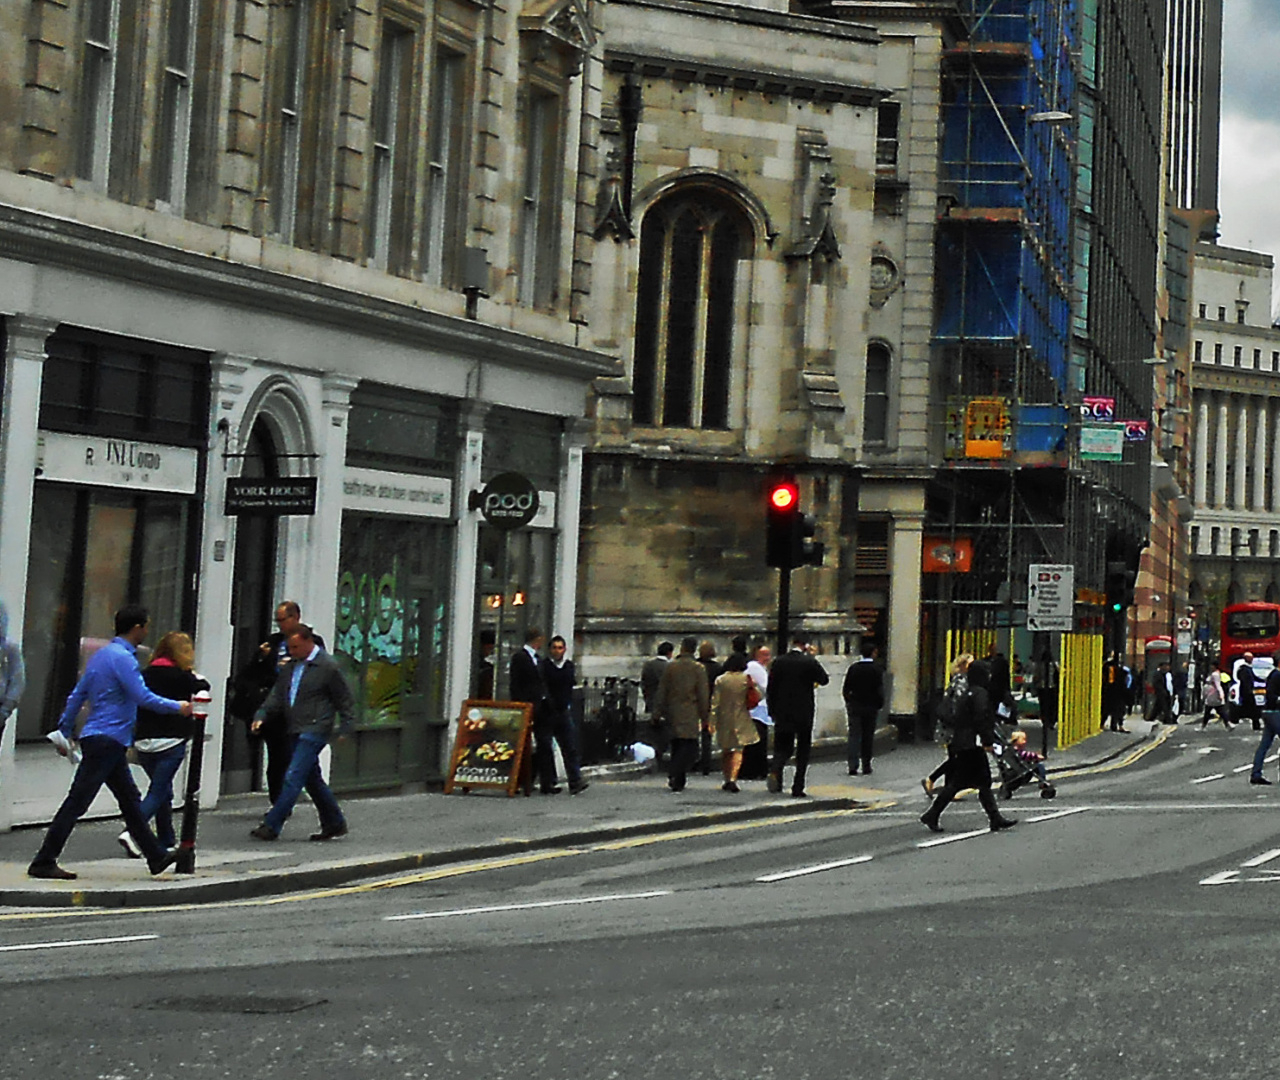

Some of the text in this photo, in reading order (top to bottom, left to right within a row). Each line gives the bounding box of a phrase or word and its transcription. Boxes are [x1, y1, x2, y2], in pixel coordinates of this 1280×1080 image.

[234, 486, 309, 496] YORK HOUSE
[485, 491, 533, 513] pod
[456, 767, 498, 775] COOKED
